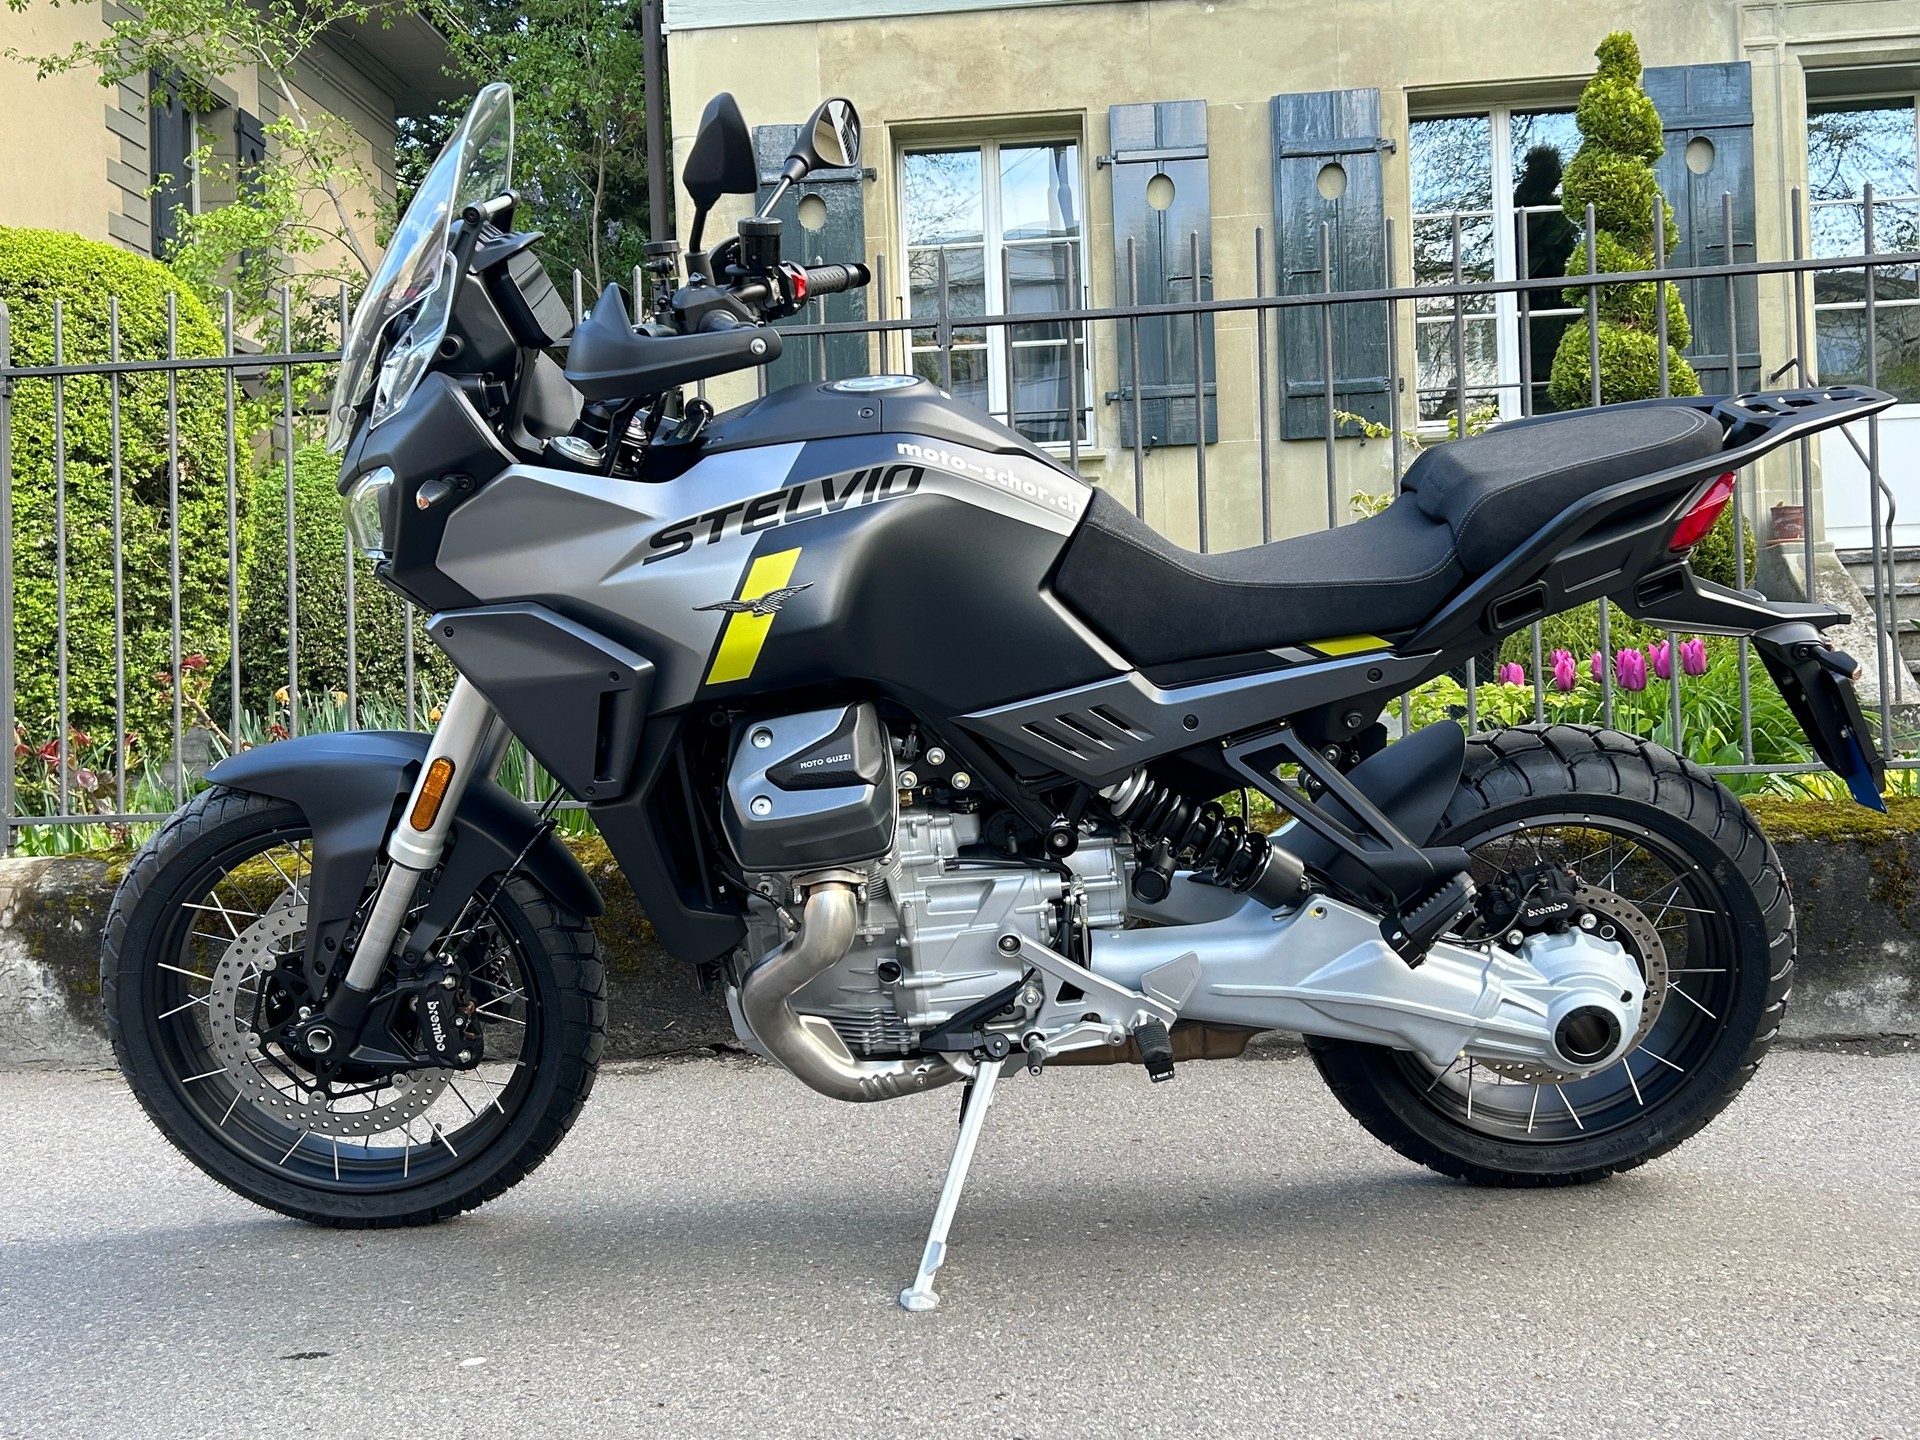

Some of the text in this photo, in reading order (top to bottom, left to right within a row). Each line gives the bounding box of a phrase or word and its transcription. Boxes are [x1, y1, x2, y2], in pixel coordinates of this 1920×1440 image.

[896, 442, 1081, 515] moto-schor.ch
[643, 464, 925, 566] STELVIO
[800, 753, 852, 769] MOTO GUZZI
[1527, 902, 1569, 918] brembo
[427, 1000, 447, 1052] brembo
